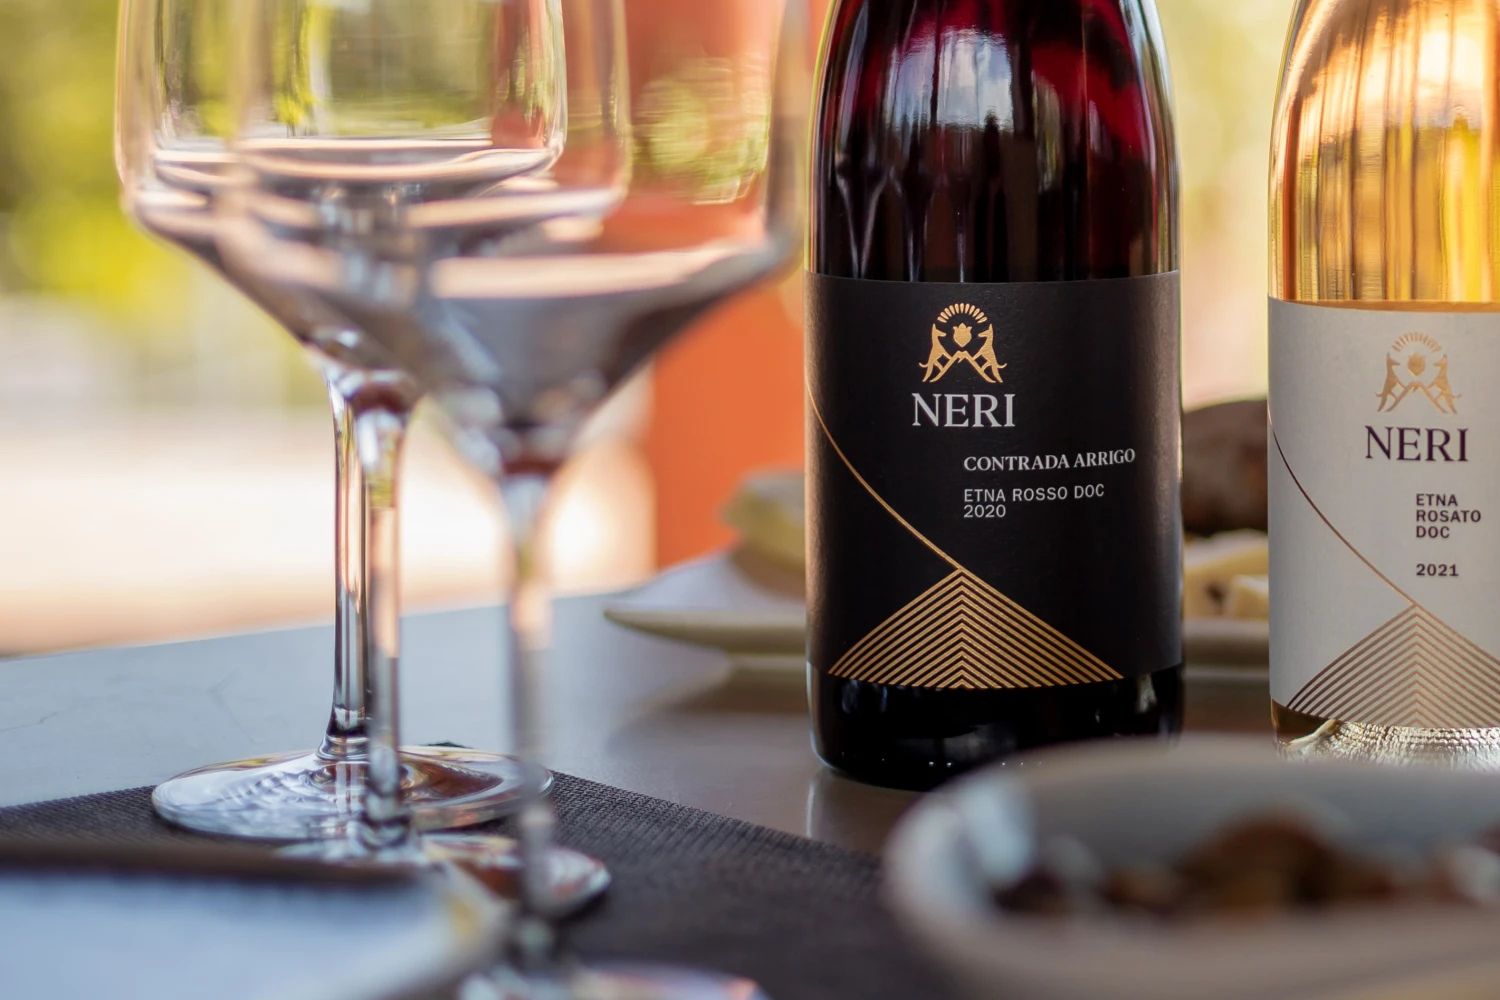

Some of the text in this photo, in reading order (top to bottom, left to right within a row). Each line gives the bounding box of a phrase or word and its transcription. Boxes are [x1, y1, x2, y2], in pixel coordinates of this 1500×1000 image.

[912, 393, 1016, 427] NERI
[1365, 425, 1469, 462] NERI
[963, 448, 1136, 472] CONTRADA ARRIGO
[963, 483, 1105, 502] ETNA ROSSO DOC
[1416, 493, 1459, 506] ETNA
[963, 504, 1007, 518] 2020
[1416, 509, 1482, 523] ROSATO
[1416, 525, 1451, 539] DOC
[1416, 563, 1459, 577] 2021
